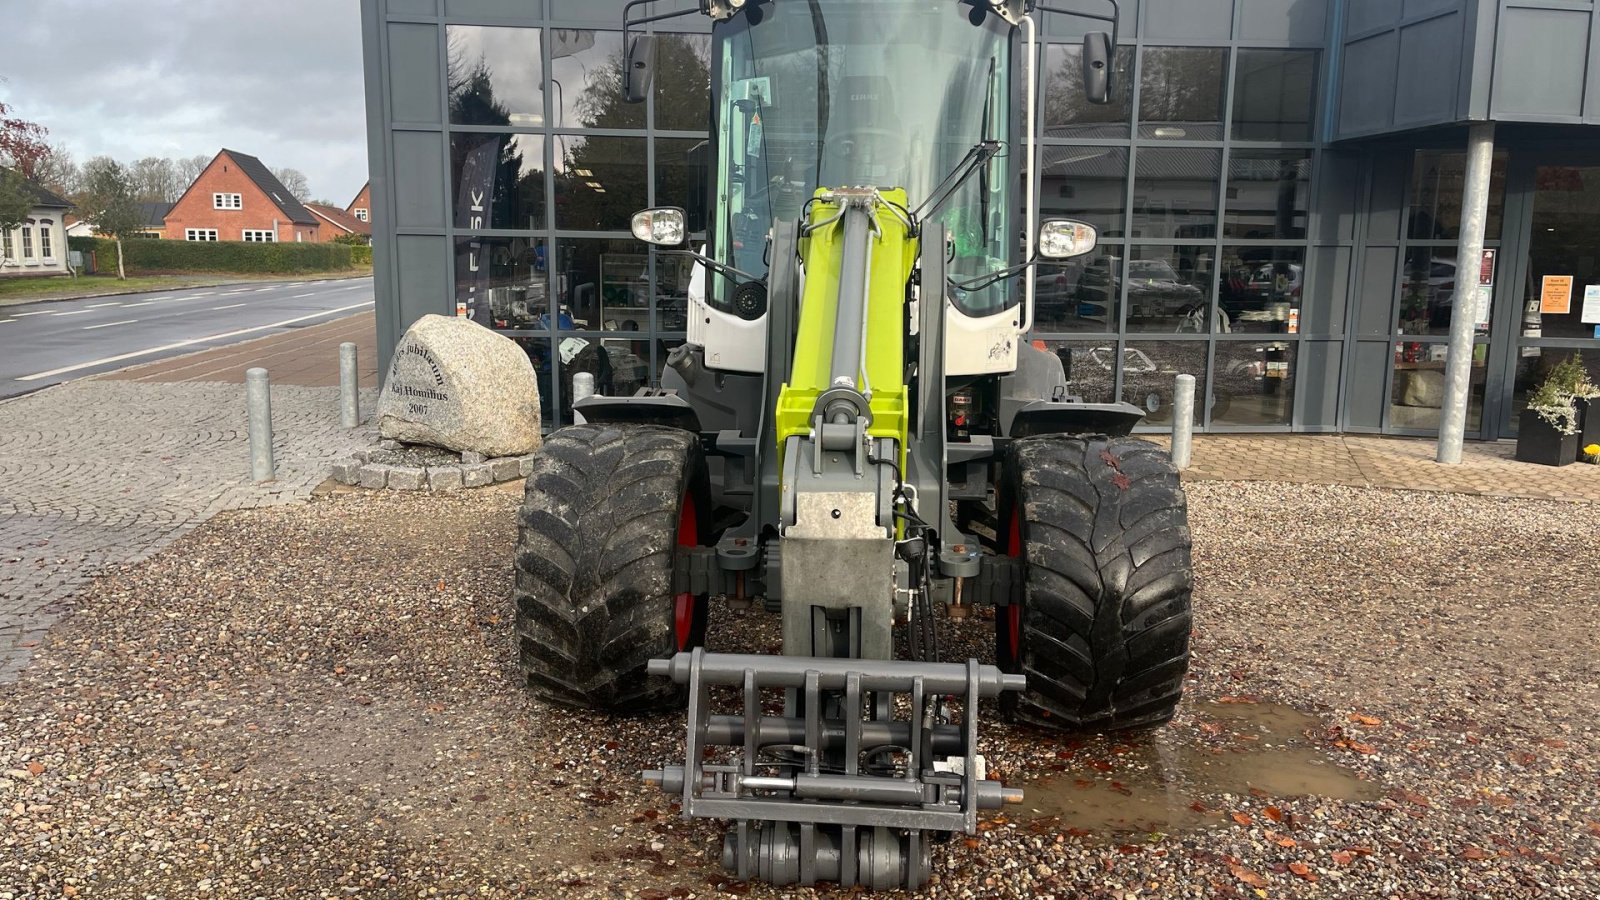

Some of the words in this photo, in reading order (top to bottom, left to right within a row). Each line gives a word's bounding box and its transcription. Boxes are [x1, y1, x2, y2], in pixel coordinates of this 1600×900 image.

[391, 383, 403, 396] Kaj
[404, 386, 449, 401] Homilius
[408, 403, 428, 415] 2007
